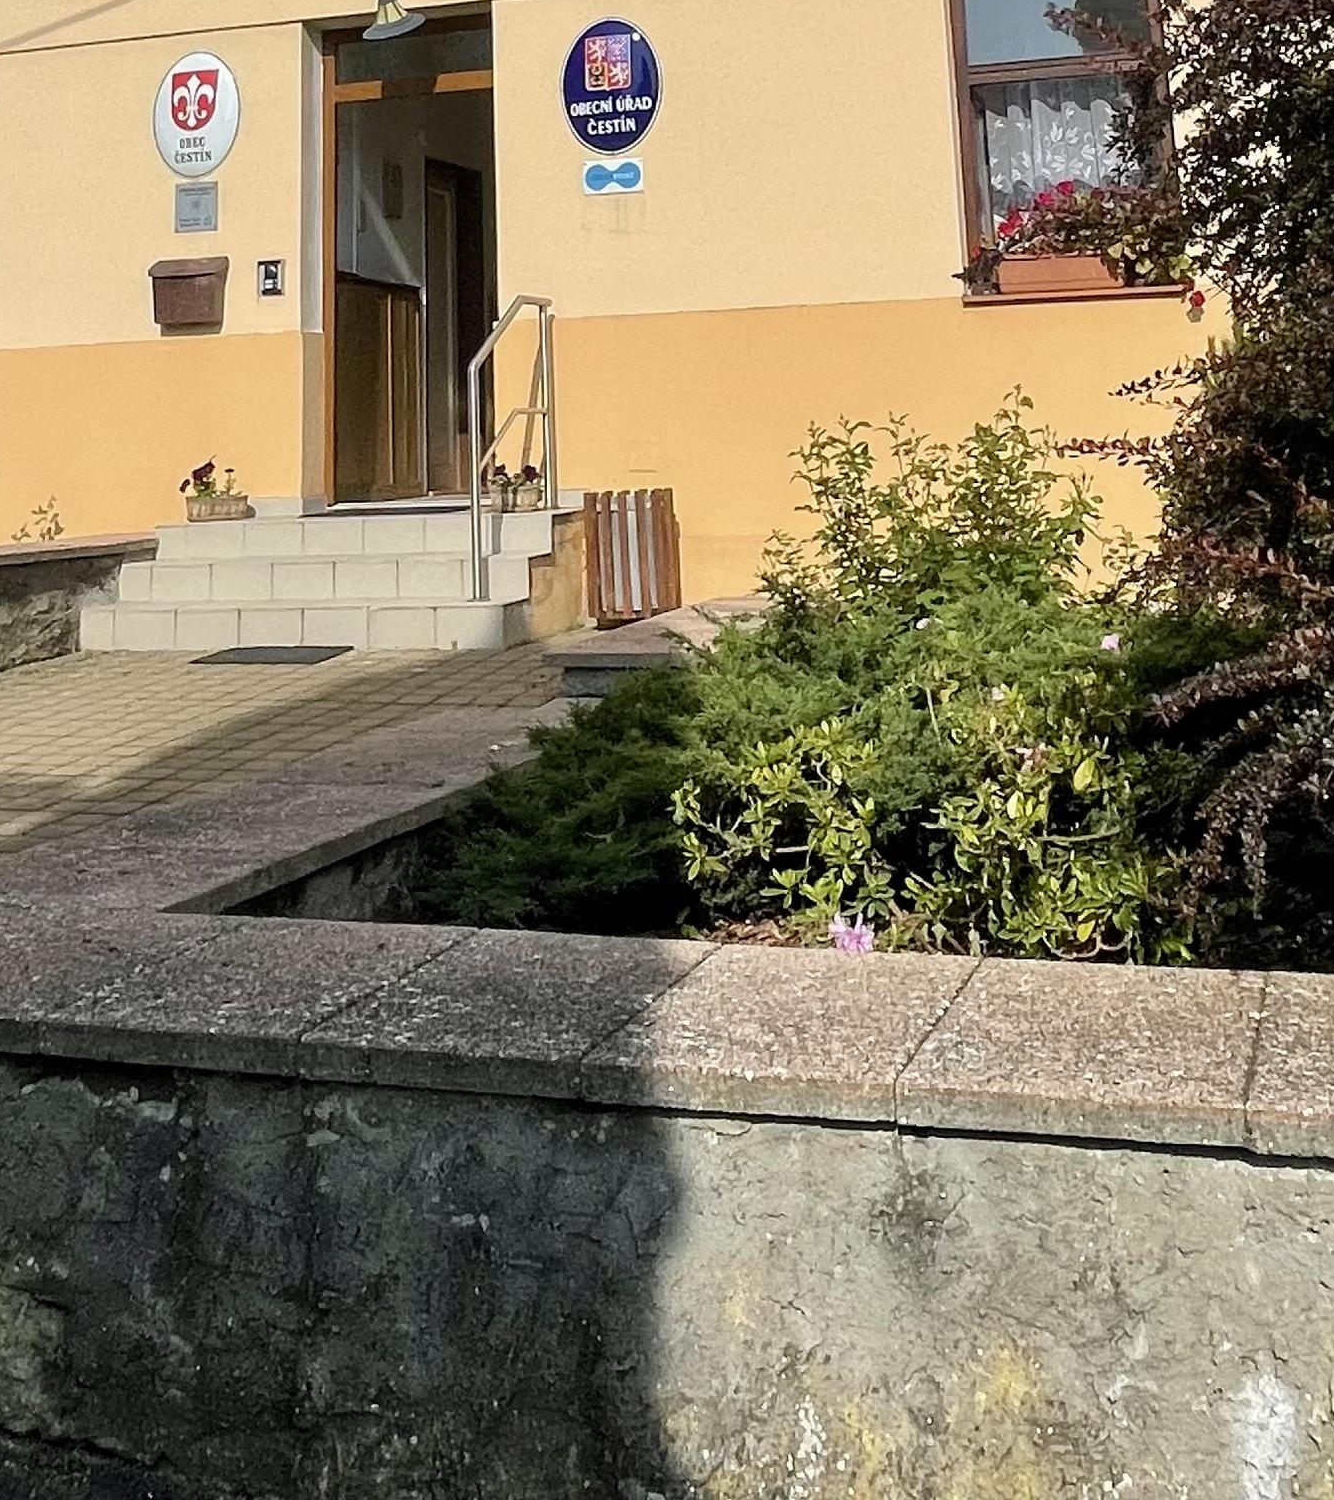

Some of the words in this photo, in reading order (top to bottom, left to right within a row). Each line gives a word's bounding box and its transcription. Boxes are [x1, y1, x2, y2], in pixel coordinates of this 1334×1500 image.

[570, 96, 613, 116] OBECNÍ
[616, 94, 653, 112] ÚŘAD
[587, 114, 636, 135] ČESTÍN
[179, 137, 206, 149] OBEC
[174, 148, 212, 164] ČESTÍN
